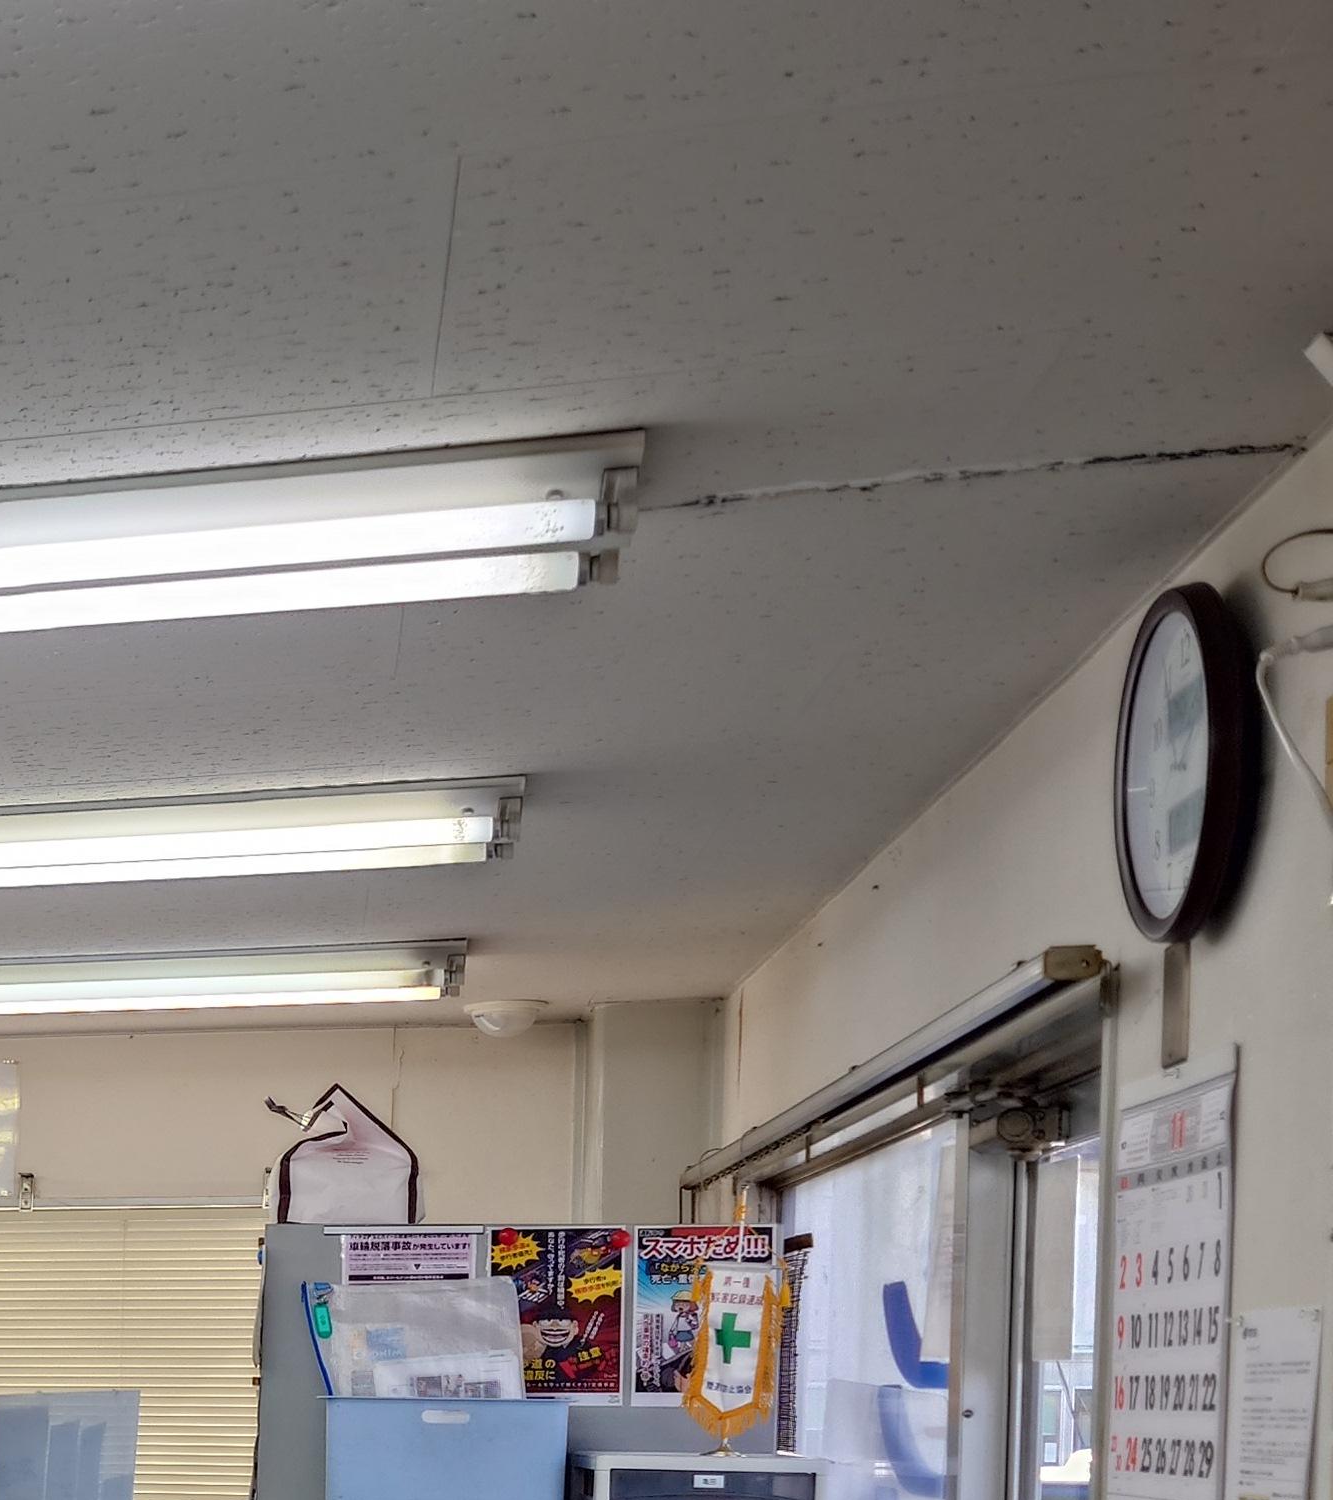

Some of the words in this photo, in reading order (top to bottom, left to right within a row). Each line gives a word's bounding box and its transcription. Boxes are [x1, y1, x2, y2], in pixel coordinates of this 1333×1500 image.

[1119, 1255, 1128, 1290] 2
[1135, 1253, 1143, 1288] 3
[1152, 1249, 1159, 1286] 4
[1167, 1247, 1175, 1284] 5
[1183, 1244, 1190, 1282] 6
[1197, 1241, 1206, 1280] 7
[1214, 1238, 1221, 1278] 8
[1117, 1315, 1125, 1349] 9
[1131, 1314, 1142, 1349] 10
[1148, 1313, 1159, 1349] 11
[1163, 1311, 1175, 1347] 12
[1178, 1309, 1188, 1347] 13
[1192, 1307, 1203, 1346] 14
[1207, 1305, 1220, 1344] 15
[1114, 1375, 1125, 1411] 16
[1129, 1375, 1140, 1411] 17
[1144, 1375, 1156, 1411] 18
[1159, 1375, 1171, 1411] 19
[1172, 1374, 1186, 1411] 20
[1188, 1373, 1199, 1411] 21
[1202, 1373, 1217, 1412] 22
[1125, 1436, 1139, 1473] 24
[1140, 1437, 1153, 1473] 25
[1155, 1438, 1167, 1474] 26
[1169, 1439, 1182, 1476] 27
[1182, 1439, 1195, 1477] 28
[1198, 1440, 1214, 1479] 29
